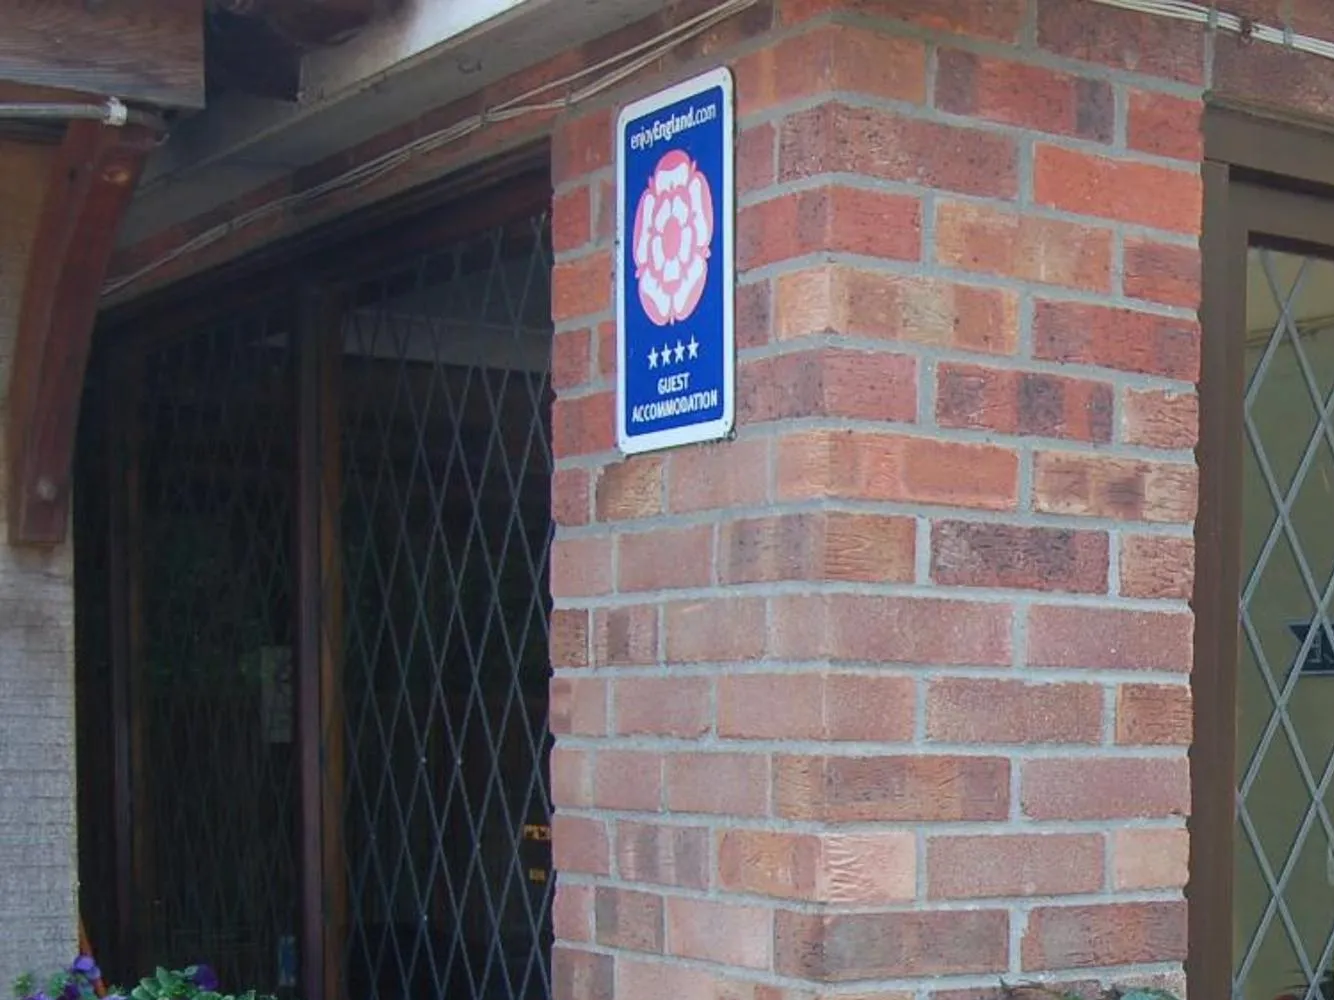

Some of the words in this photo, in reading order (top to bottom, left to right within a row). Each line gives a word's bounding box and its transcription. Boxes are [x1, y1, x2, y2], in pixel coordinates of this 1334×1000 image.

[631, 104, 717, 150] enjoyEngland.com
[657, 373, 690, 395] GUEST
[631, 389, 717, 422] ACCOMMODATION
